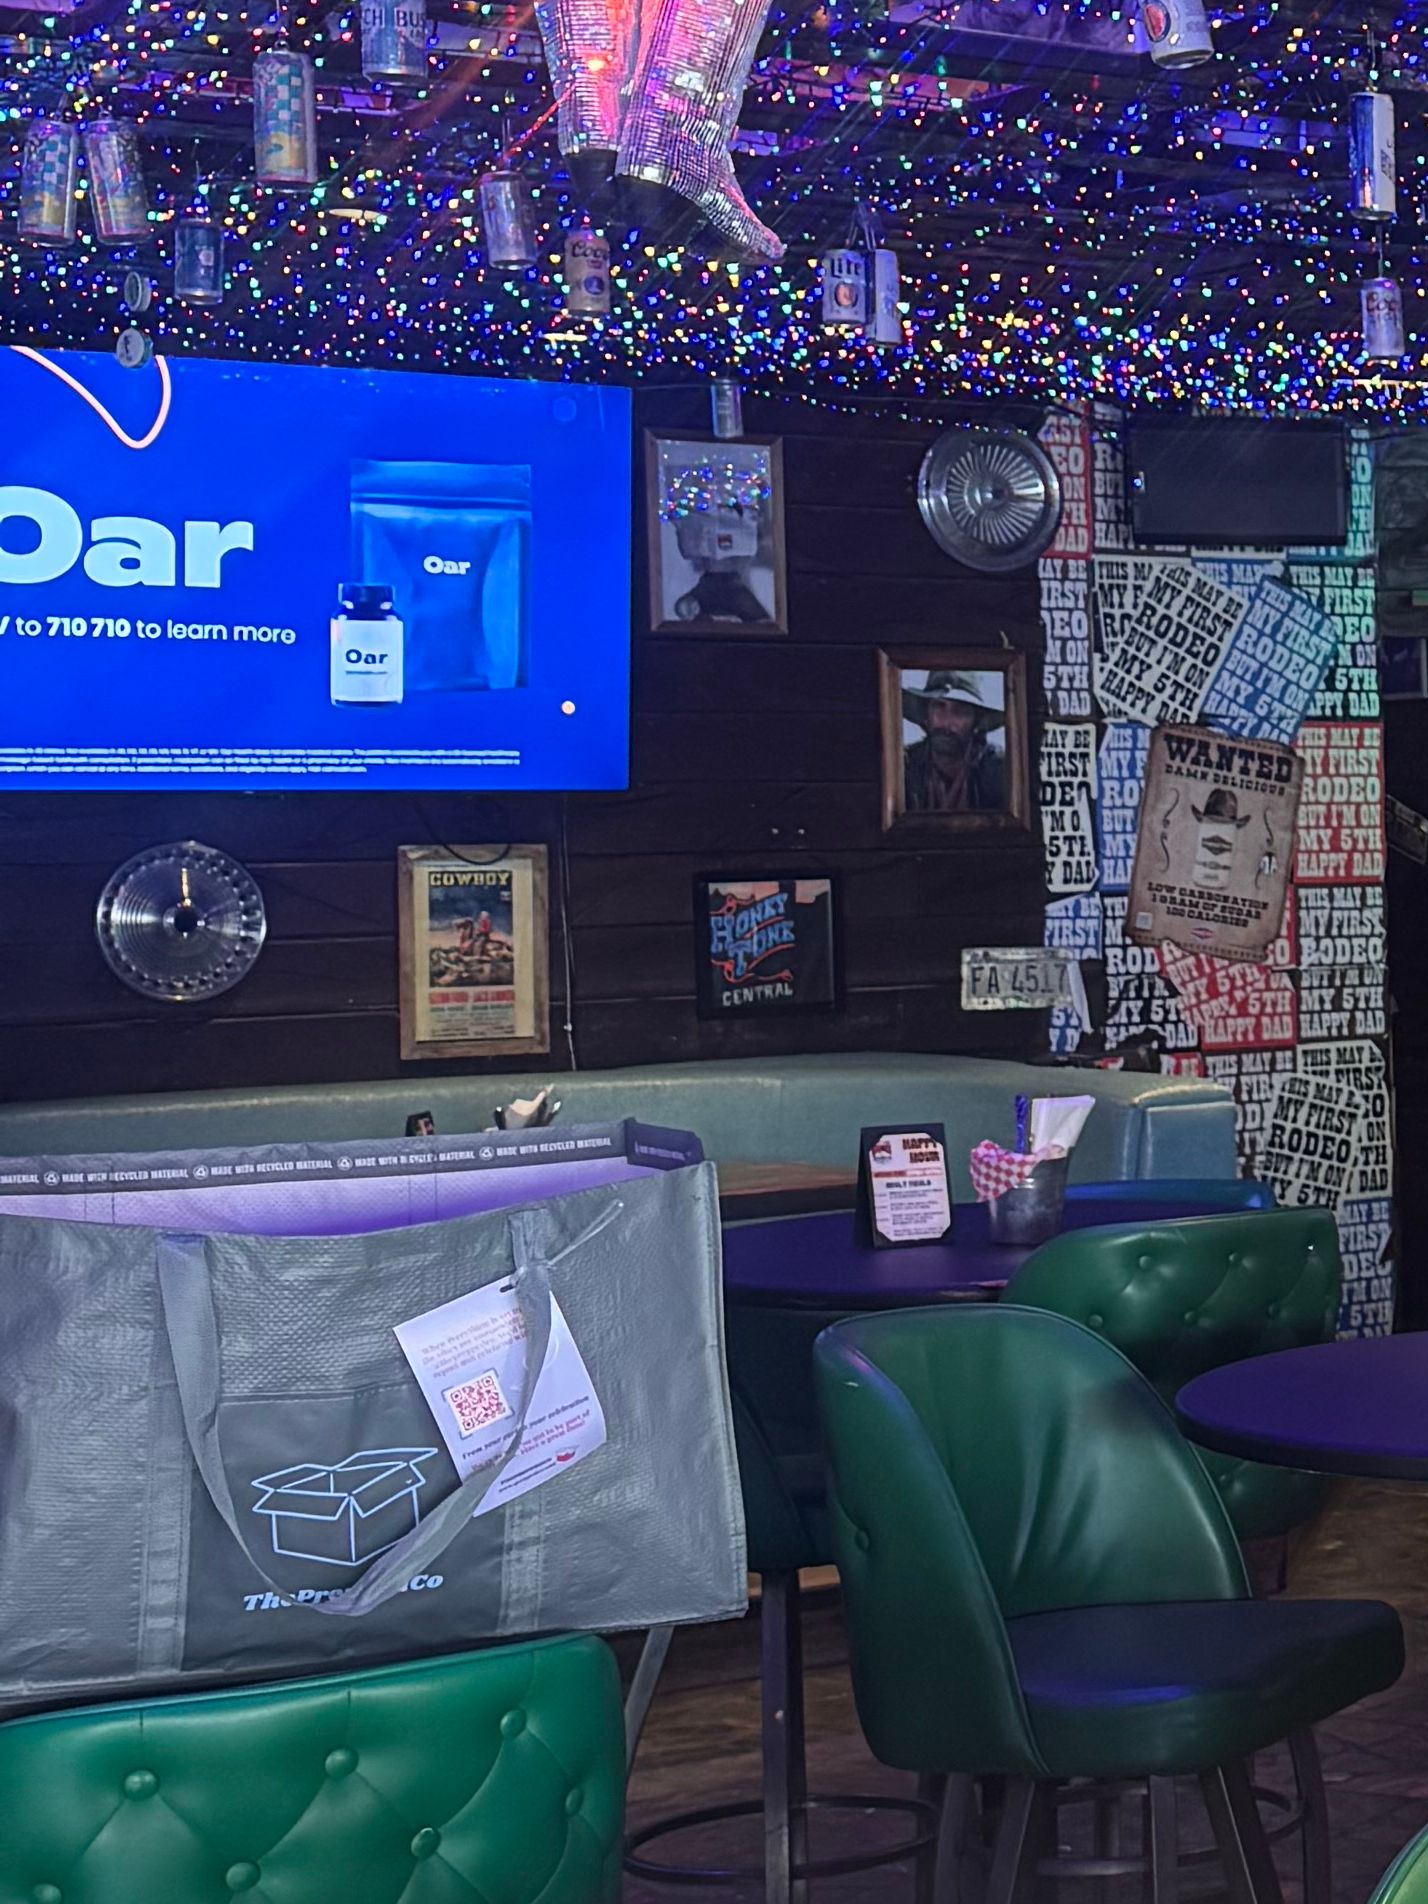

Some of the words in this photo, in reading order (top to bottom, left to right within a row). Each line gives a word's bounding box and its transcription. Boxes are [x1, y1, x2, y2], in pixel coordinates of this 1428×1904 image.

[0, 484, 255, 588] Oar
[423, 555, 471, 576] Oar
[1149, 575, 1176, 606] MY
[1178, 590, 1234, 640] FIRST
[1192, 574, 1220, 604] MAY
[1222, 595, 1243, 619] BE
[1325, 588, 1376, 615] FIRST
[16, 617, 42, 637] to
[47, 616, 87, 637] 710
[91, 617, 131, 638] 710
[137, 619, 161, 639] to
[167, 619, 227, 640] learn
[234, 625, 297, 644] more
[1135, 604, 1222, 668] RODEO
[1251, 598, 1282, 631] MY
[1283, 618, 1334, 667] FIRST
[345, 648, 388, 665] Oar
[1127, 624, 1154, 652] BUT
[1158, 645, 1185, 674] I'M
[1235, 627, 1319, 687] RODEO
[1101, 672, 1157, 714] HAPPY
[1114, 646, 1151, 686] MY
[1155, 672, 1200, 713] 5TH
[1335, 668, 1377, 690] 5TH
[1215, 672, 1250, 704] MY
[1253, 691, 1297, 733] 5TH
[1350, 692, 1379, 718] DAD
[1329, 726, 1360, 747] MAY
[1164, 734, 1292, 784] WANTED
[1332, 748, 1379, 775] FIRST
[1165, 764, 1210, 783] DAMN
[1213, 772, 1286, 797] DELICIOUS
[1301, 776, 1380, 802] RODEO
[1298, 827, 1332, 850] MY
[1341, 827, 1382, 850] 5TH
[1297, 853, 1349, 876] HAPPY
[1352, 853, 1382, 876] DAD
[430, 872, 511, 887] COWBOY
[1148, 882, 1176, 895] LOW
[1179, 886, 1269, 911] CARBONATION
[710, 892, 788, 953] HONKY
[1187, 908, 1250, 928] CALORIES
[729, 920, 795, 978] TONK
[722, 982, 793, 1007] CENTRAL
[970, 965, 1001, 996] FA
[1301, 989, 1332, 1012] MY
[1341, 988, 1383, 1011] 5TH
[1300, 1013, 1352, 1039] HAPPY
[1354, 1011, 1385, 1036] DAD
[496, 1145, 518, 1157] MADE
[540, 1142, 575, 1154] RECYCLED
[577, 1137, 611, 1149] MATERIAL
[1268, 1123, 1352, 1163] RODEO
[62, 1172, 84, 1184] MADE
[87, 1172, 107, 1182] WITH
[110, 1170, 149, 1182] RECYCLED
[151, 1168, 189, 1179] MATERIAL
[211, 1165, 233, 1176] MADE
[235, 1164, 255, 1174] WITH
[257, 1161, 295, 1173] RECYCLED
[296, 1159, 333, 1170] MATERIAL
